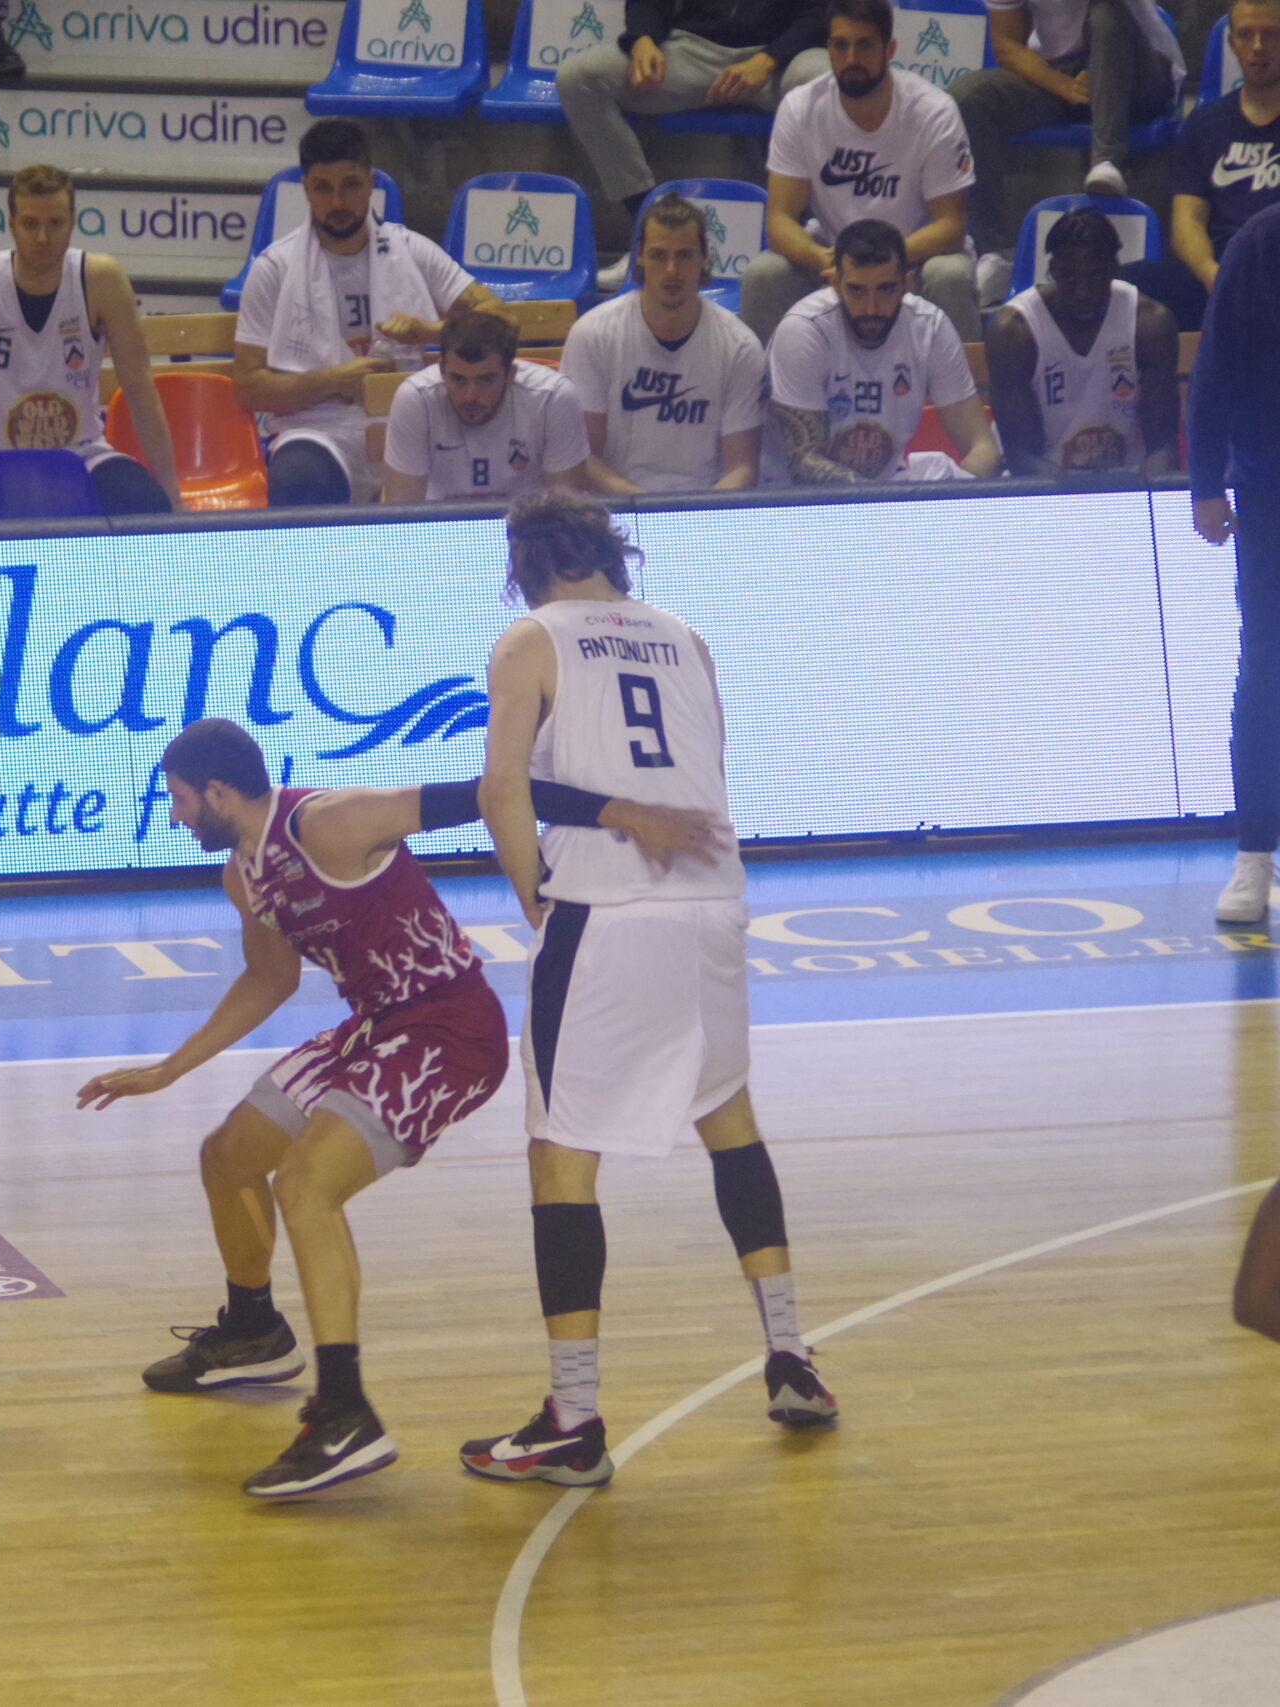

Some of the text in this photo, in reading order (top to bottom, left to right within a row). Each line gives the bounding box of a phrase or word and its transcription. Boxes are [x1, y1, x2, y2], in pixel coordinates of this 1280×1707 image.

[62, 2, 328, 48] arriva udine
[367, 35, 456, 62] arriva
[20, 101, 287, 144] arriva udine
[830, 147, 877, 174] JUST
[1224, 142, 1275, 167] JUST
[121, 197, 247, 241] udine
[474, 238, 564, 267] arriva
[345, 294, 370, 327] 31
[632, 367, 682, 397] JUST
[855, 381, 882, 413] 29
[1045, 371, 1064, 405] 12
[22, 400, 63, 419] OLD
[473, 458, 490, 486] 8
[578, 635, 679, 667] ANTONUTTI
[617, 672, 676, 768] 9
